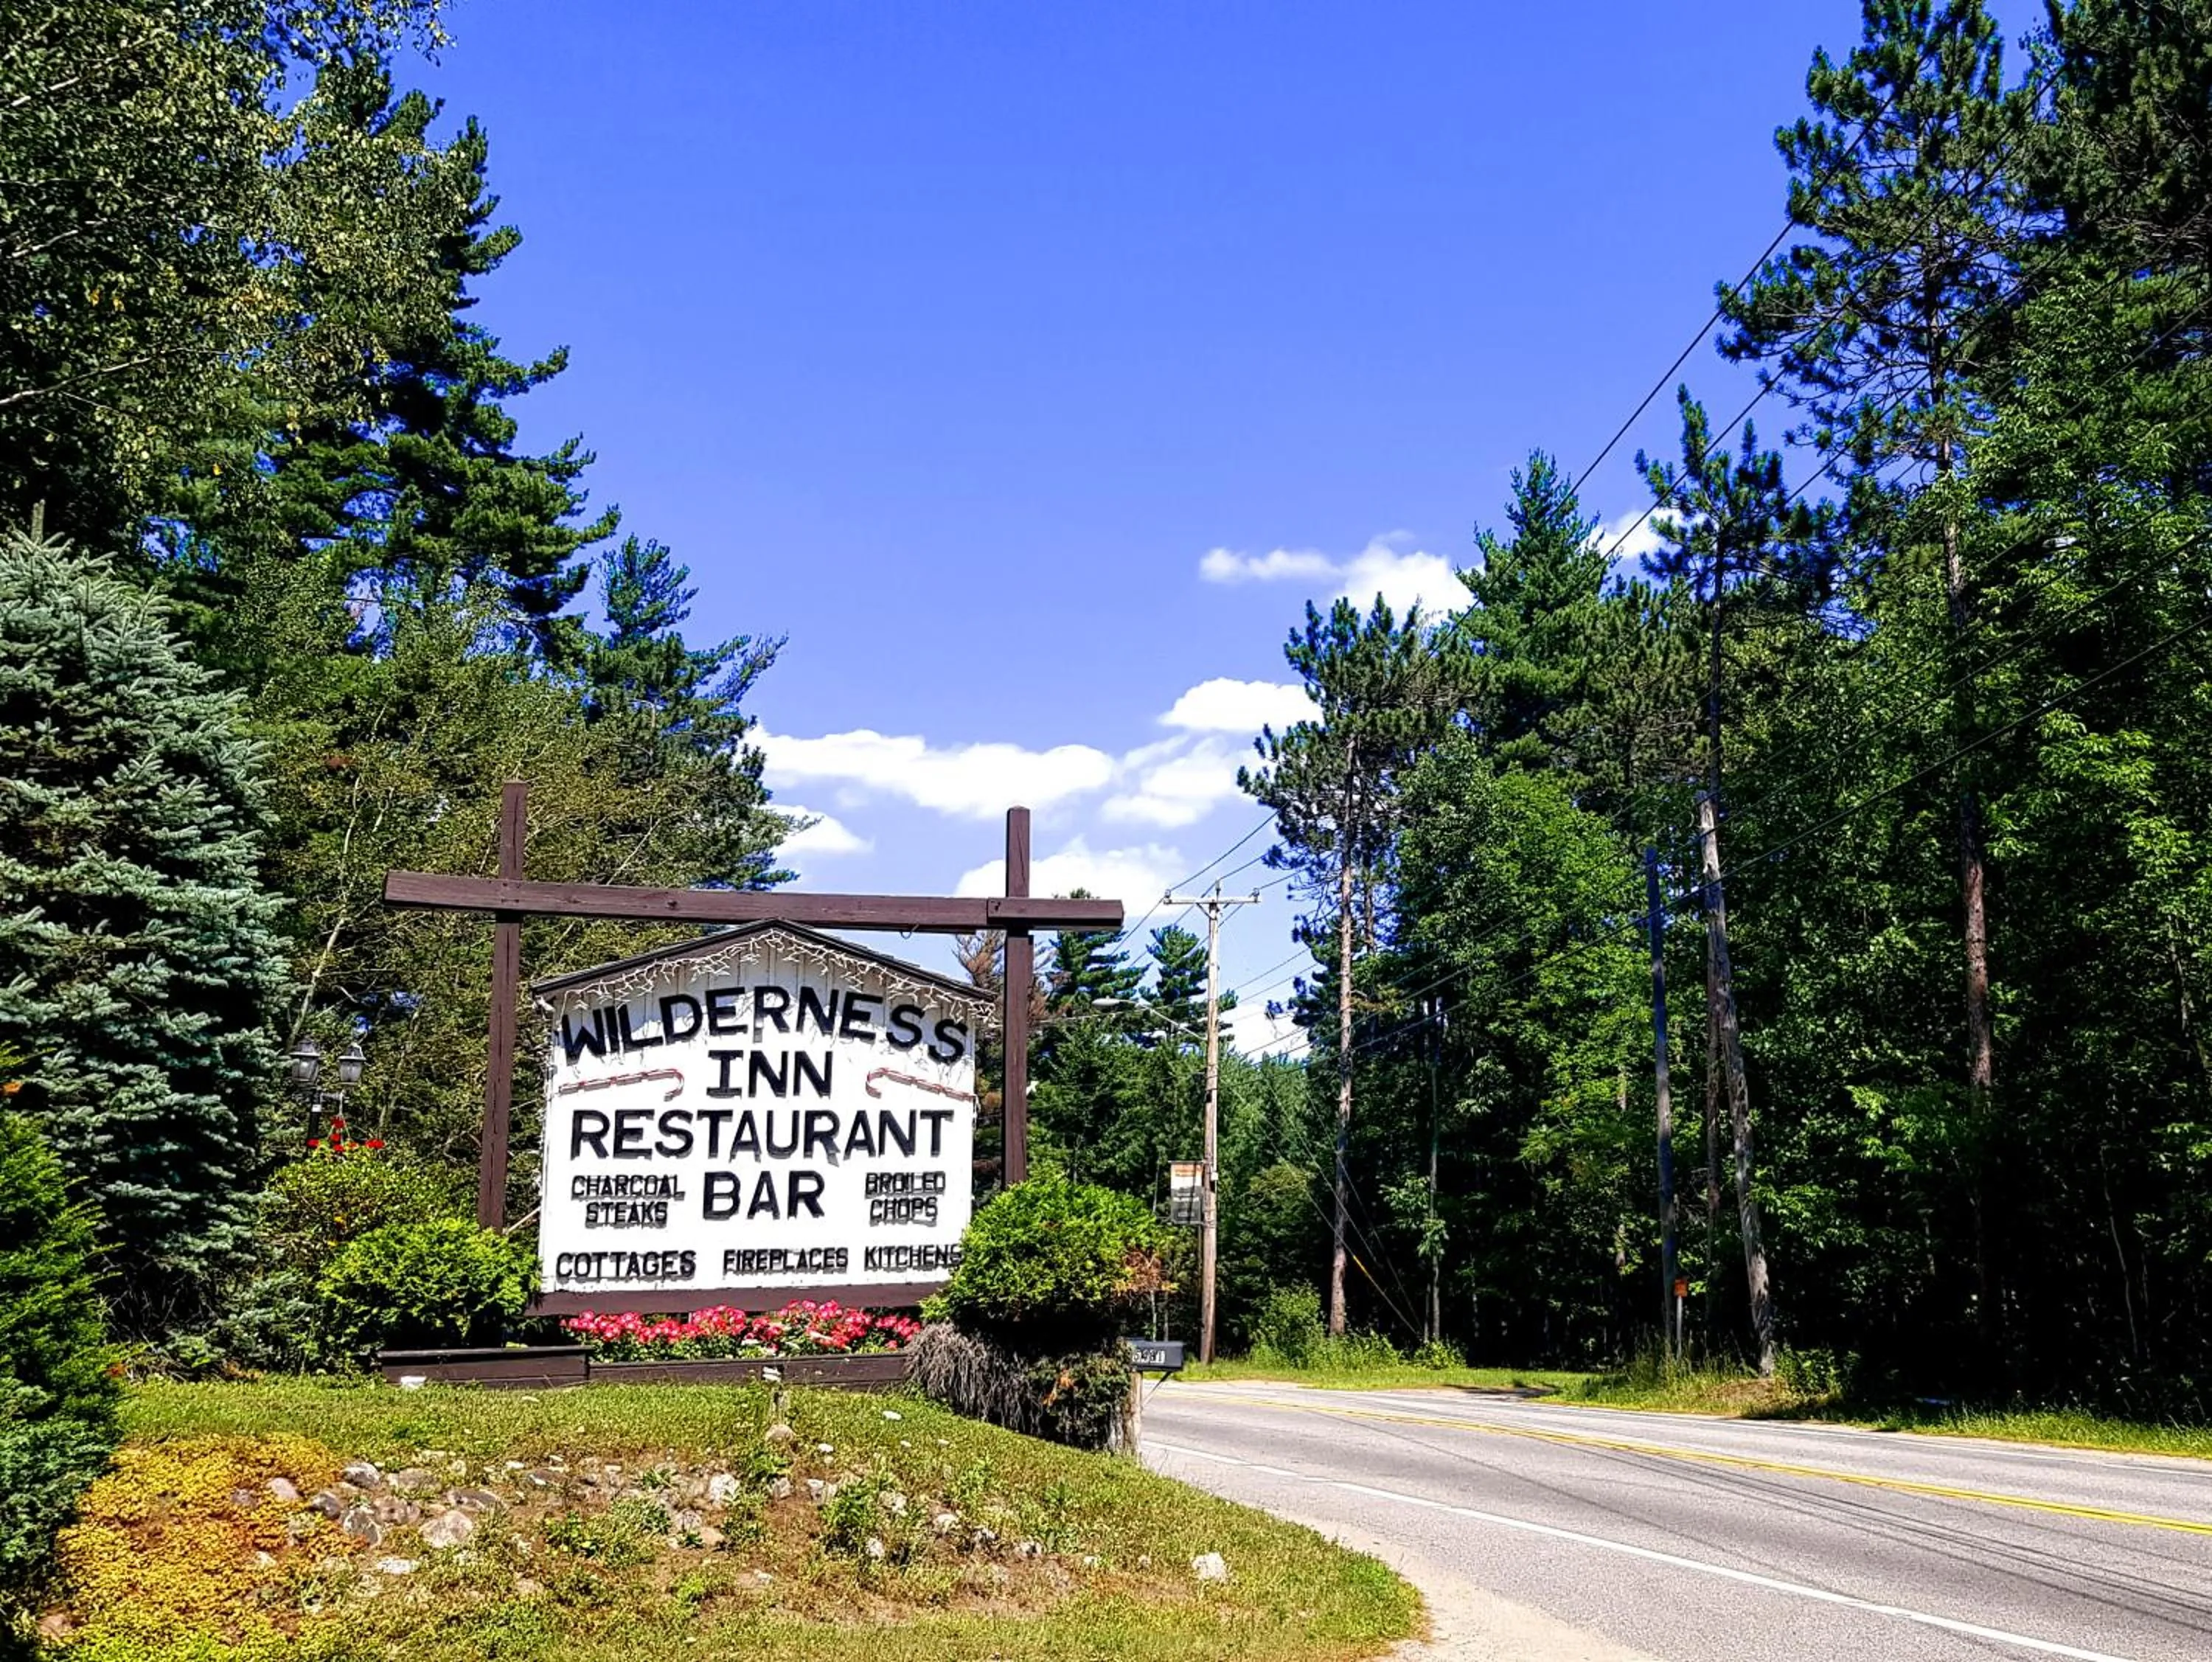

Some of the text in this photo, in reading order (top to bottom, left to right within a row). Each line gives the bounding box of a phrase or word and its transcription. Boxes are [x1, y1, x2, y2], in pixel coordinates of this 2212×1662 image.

[562, 986, 967, 1065] WILDERNESS
[706, 1049, 832, 1099] INN
[570, 1109, 954, 1163] RESTAURANT
[571, 1174, 685, 1200] CHARCOAL
[703, 1170, 825, 1220] BAR
[865, 1171, 945, 1197] BROILED
[585, 1201, 668, 1228] STEAKS
[870, 1197, 938, 1225] CHOPS
[556, 1250, 697, 1282] COTTAGES
[723, 1248, 848, 1275] FIREPLACES
